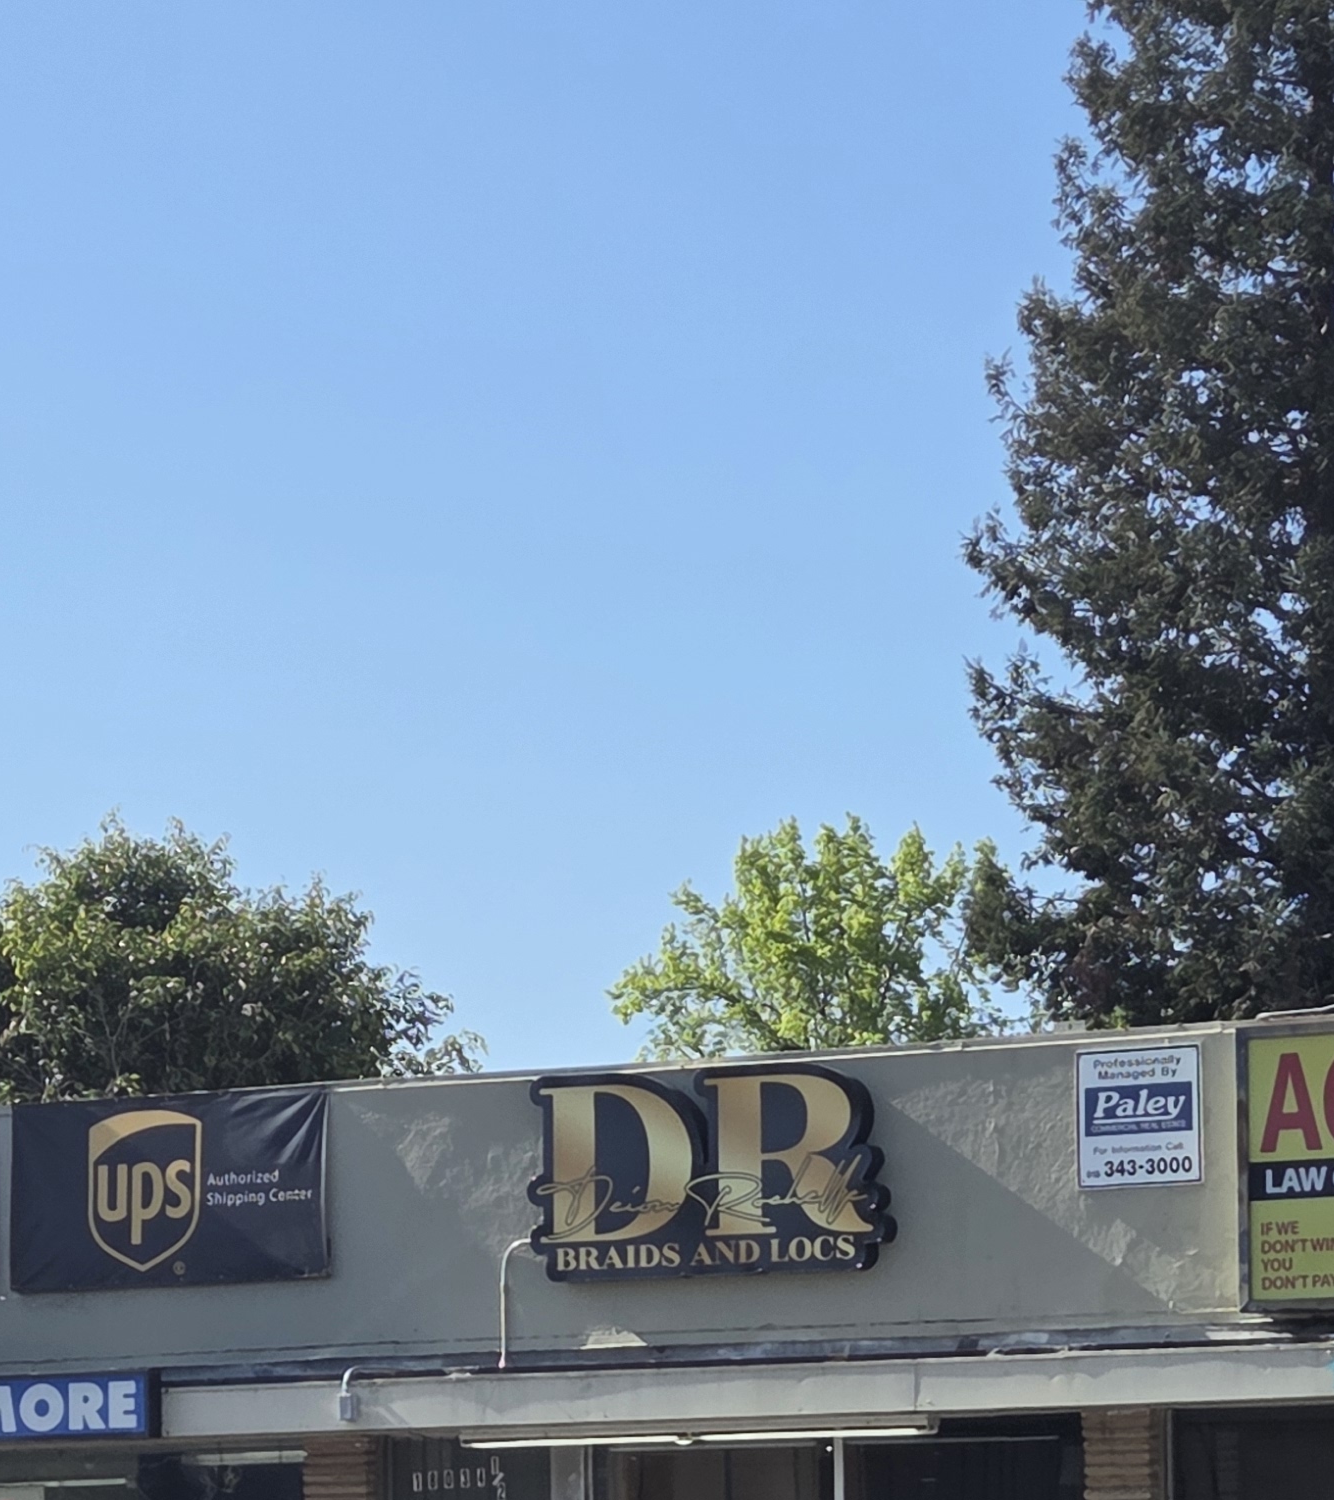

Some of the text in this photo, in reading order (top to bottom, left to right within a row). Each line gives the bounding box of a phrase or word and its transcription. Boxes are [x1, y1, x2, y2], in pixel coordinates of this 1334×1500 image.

[1098, 1068, 1156, 1080] Managed
[1093, 1088, 1186, 1120] Paley
[539, 1073, 875, 1244] DR
[1104, 1155, 1193, 1178] 343-3000
[207, 1168, 279, 1187] Authorized
[1265, 1166, 1327, 1194] LAW
[97, 1158, 193, 1246] ups
[206, 1186, 313, 1208] Shipping Center
[1261, 1221, 1300, 1236] IF WE
[556, 1235, 856, 1271] BRAIDS AND LOCS
[1261, 1258, 1293, 1273] YOU
